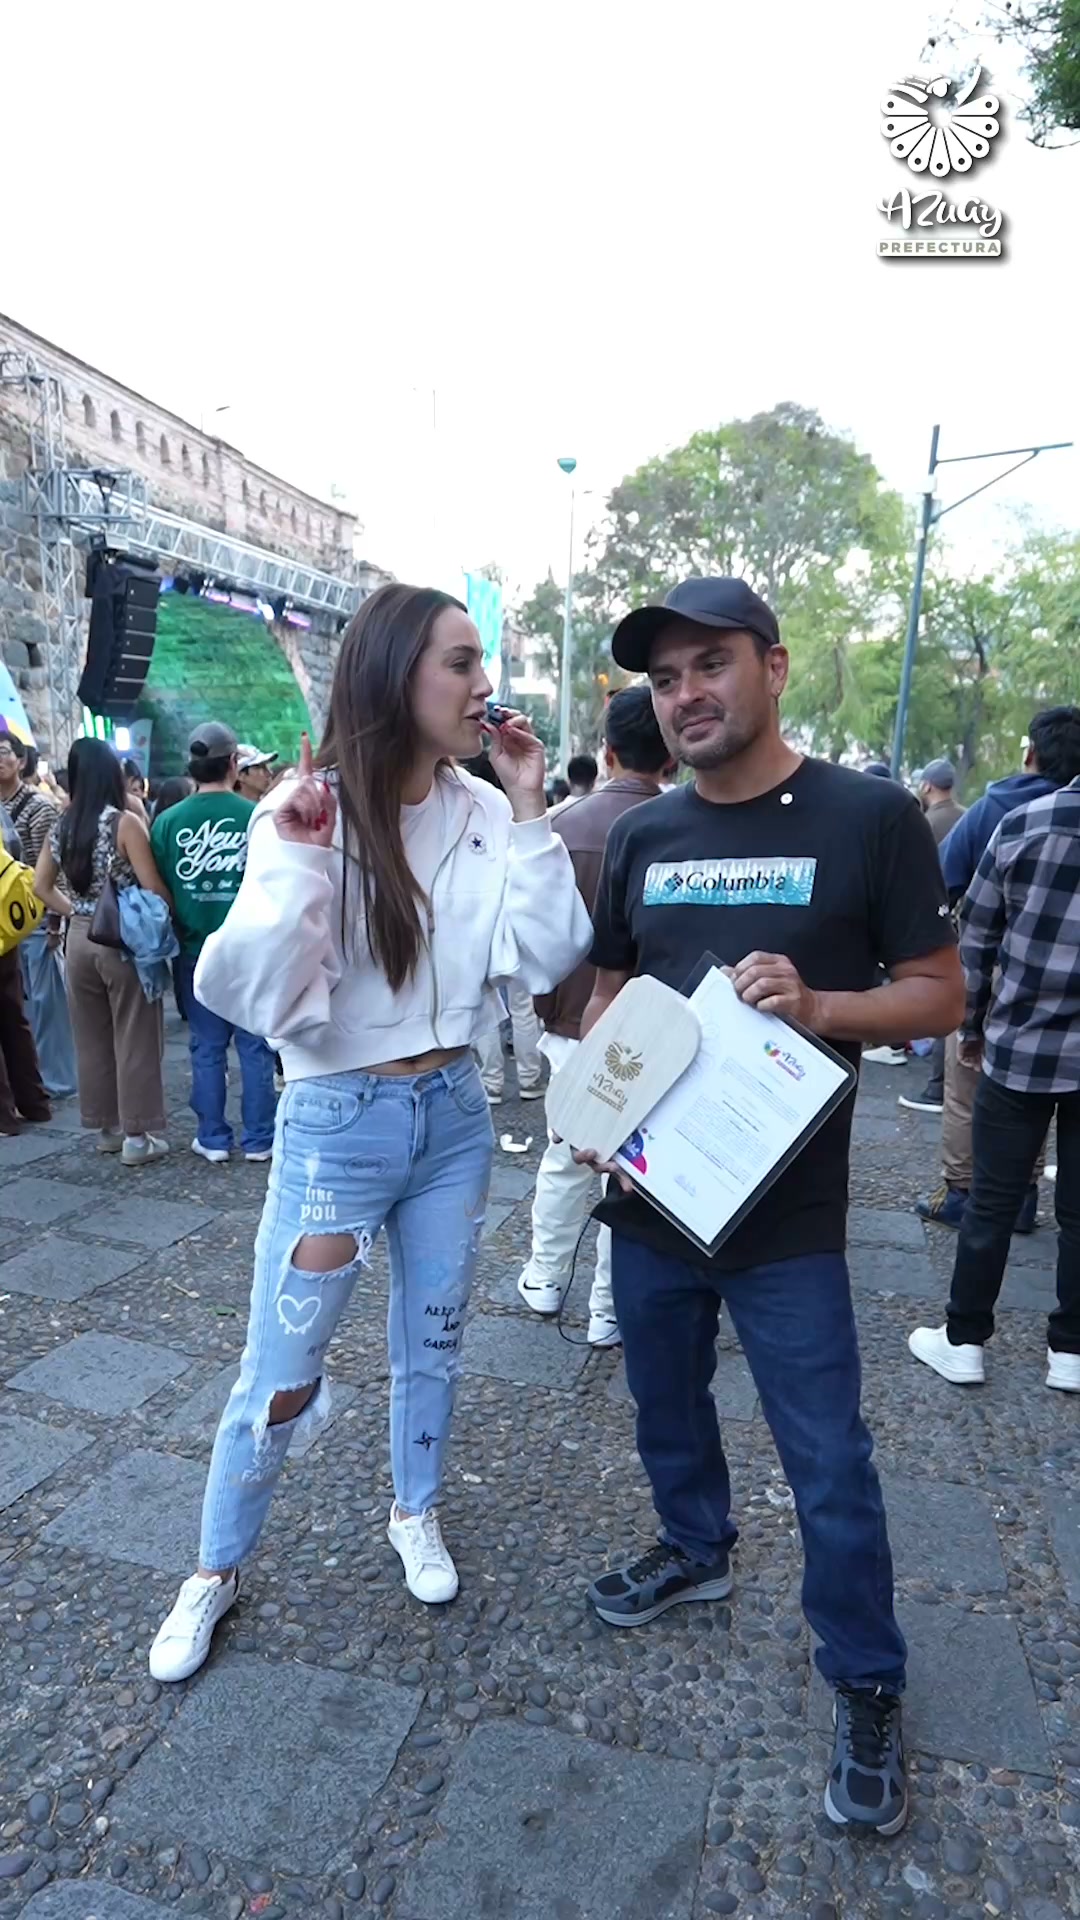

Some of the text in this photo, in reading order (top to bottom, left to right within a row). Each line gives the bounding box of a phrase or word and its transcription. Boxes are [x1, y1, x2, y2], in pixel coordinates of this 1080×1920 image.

[176, 817, 248, 849] New
[686, 870, 786, 892] Columbia
[299, 1203, 337, 1225] you
